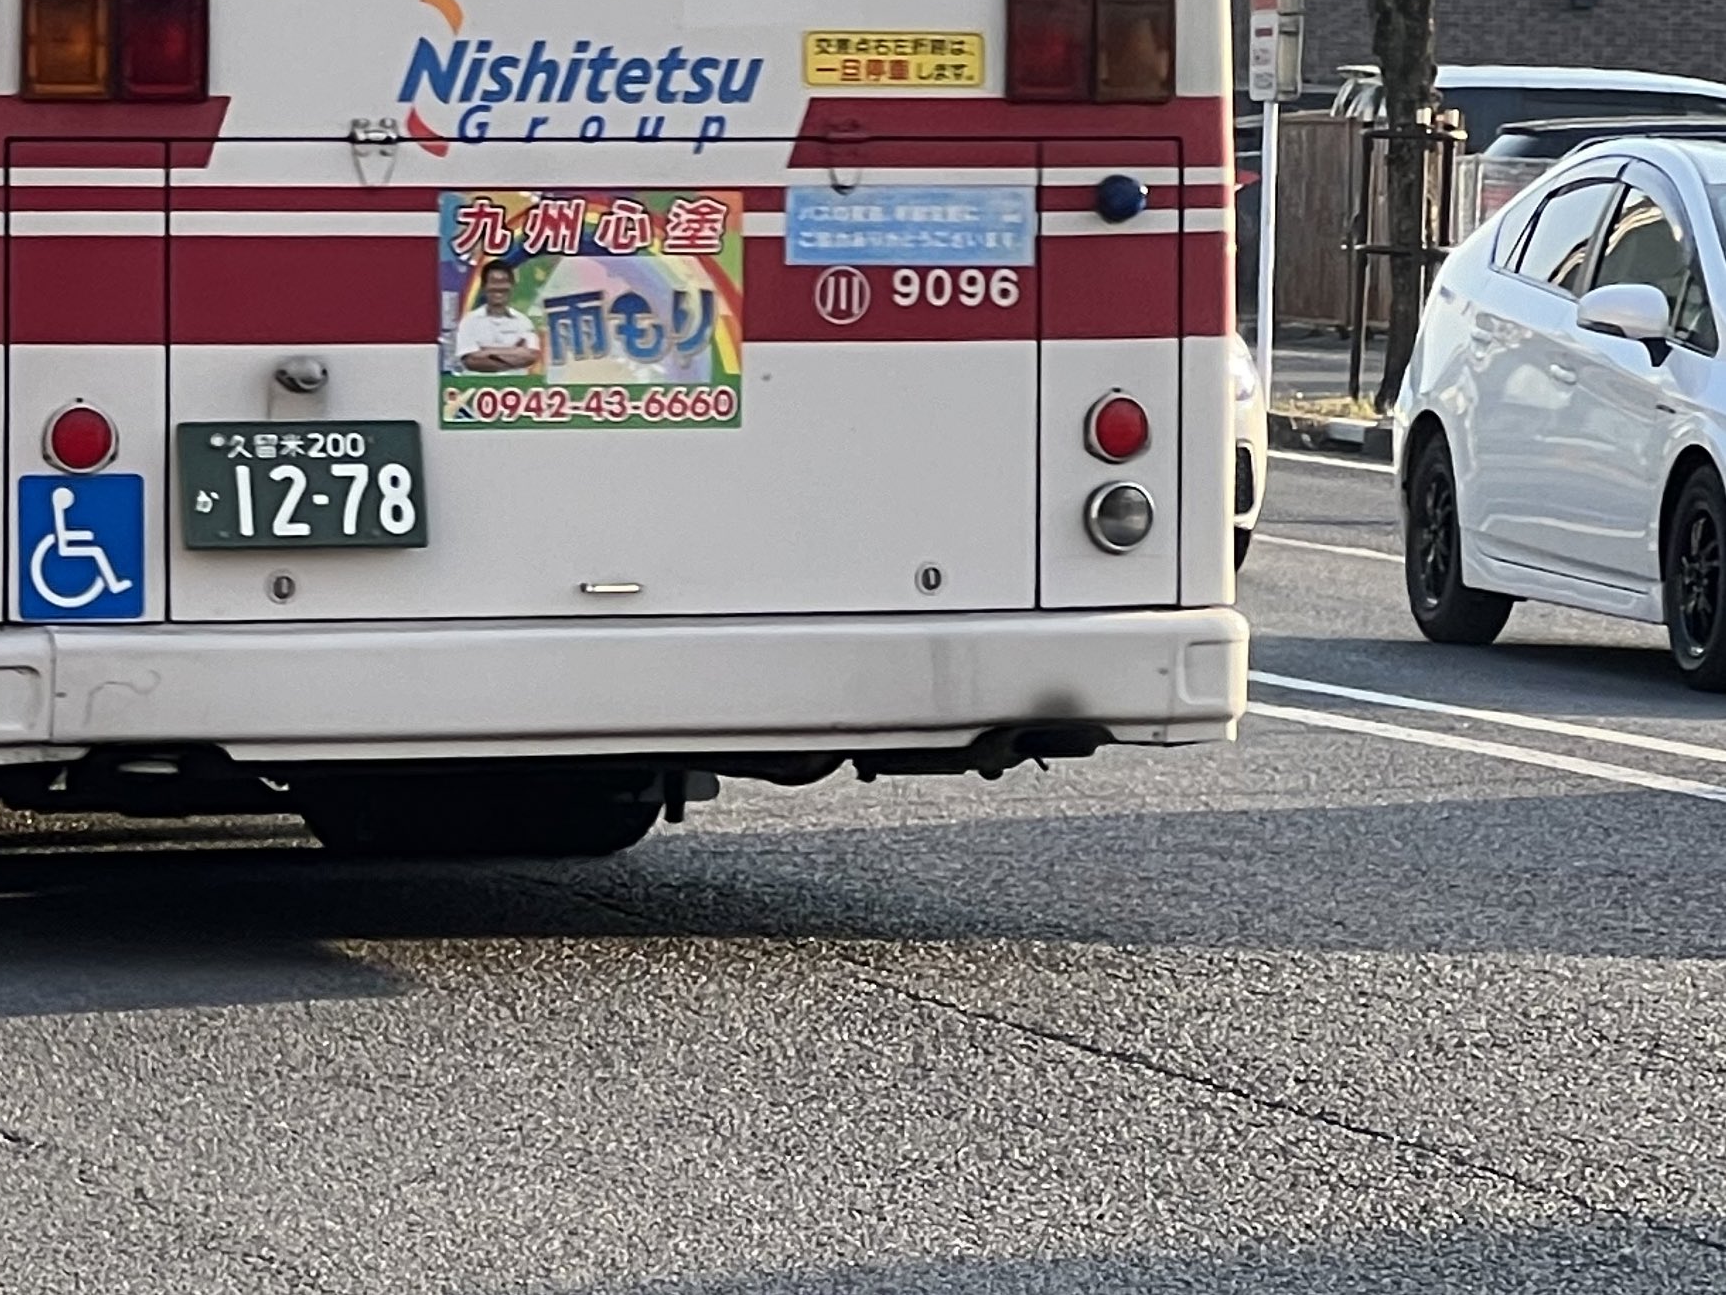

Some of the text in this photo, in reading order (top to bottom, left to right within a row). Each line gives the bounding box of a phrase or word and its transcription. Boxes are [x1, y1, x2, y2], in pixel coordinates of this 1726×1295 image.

[397, 36, 764, 105] Nishitetsu
[457, 105, 727, 155] Group
[452, 196, 729, 256] 九州心塗
[891, 268, 1020, 307] 9096
[475, 387, 737, 422] 0942-43-6660
[235, 463, 416, 537] 12-78
